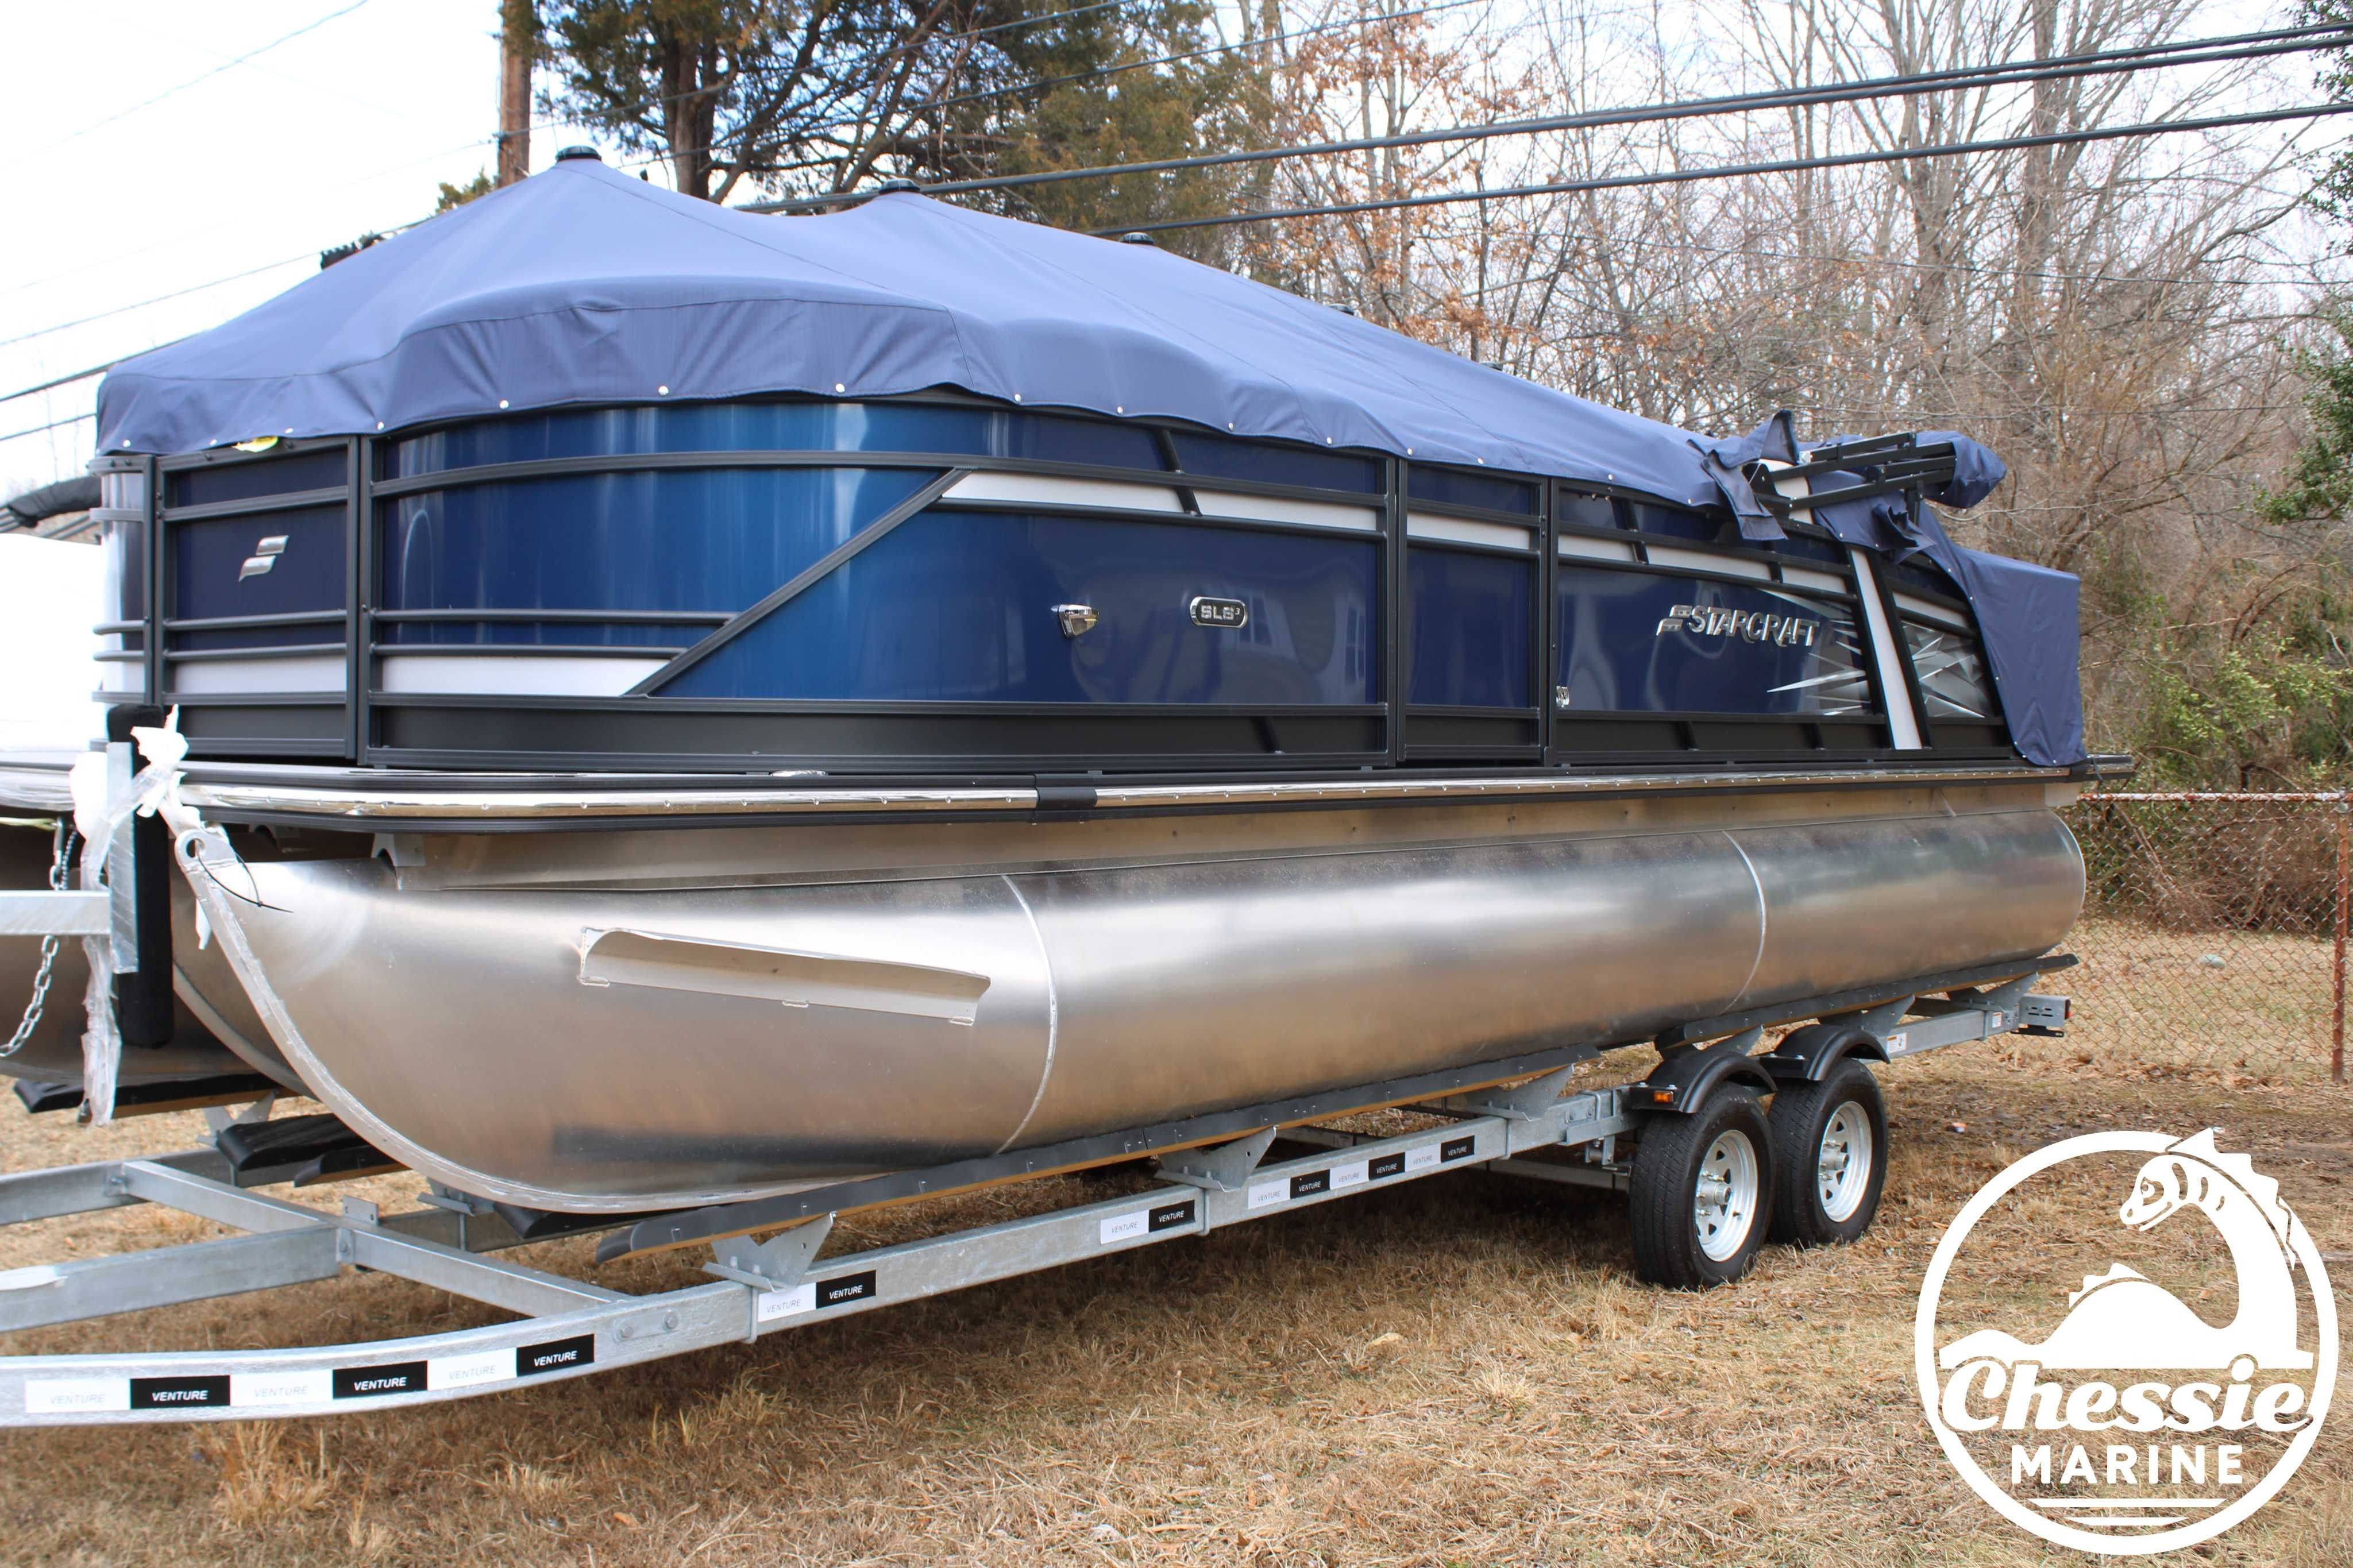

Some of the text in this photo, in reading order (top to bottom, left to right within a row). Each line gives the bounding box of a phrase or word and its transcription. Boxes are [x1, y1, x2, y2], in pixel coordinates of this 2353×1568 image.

[1688, 605, 1820, 647] STARCRAFT
[1257, 1190, 1281, 1202] VENTURE
[1298, 1181, 1322, 1193] VENTURE
[1112, 1210, 1185, 1233] VENTURE VENTURE
[767, 1284, 863, 1313] VENTURE VENTURE
[50, 1350, 577, 1404] VENTURE VENTURE VENTURE VENTURE VENTURE VENTURE
